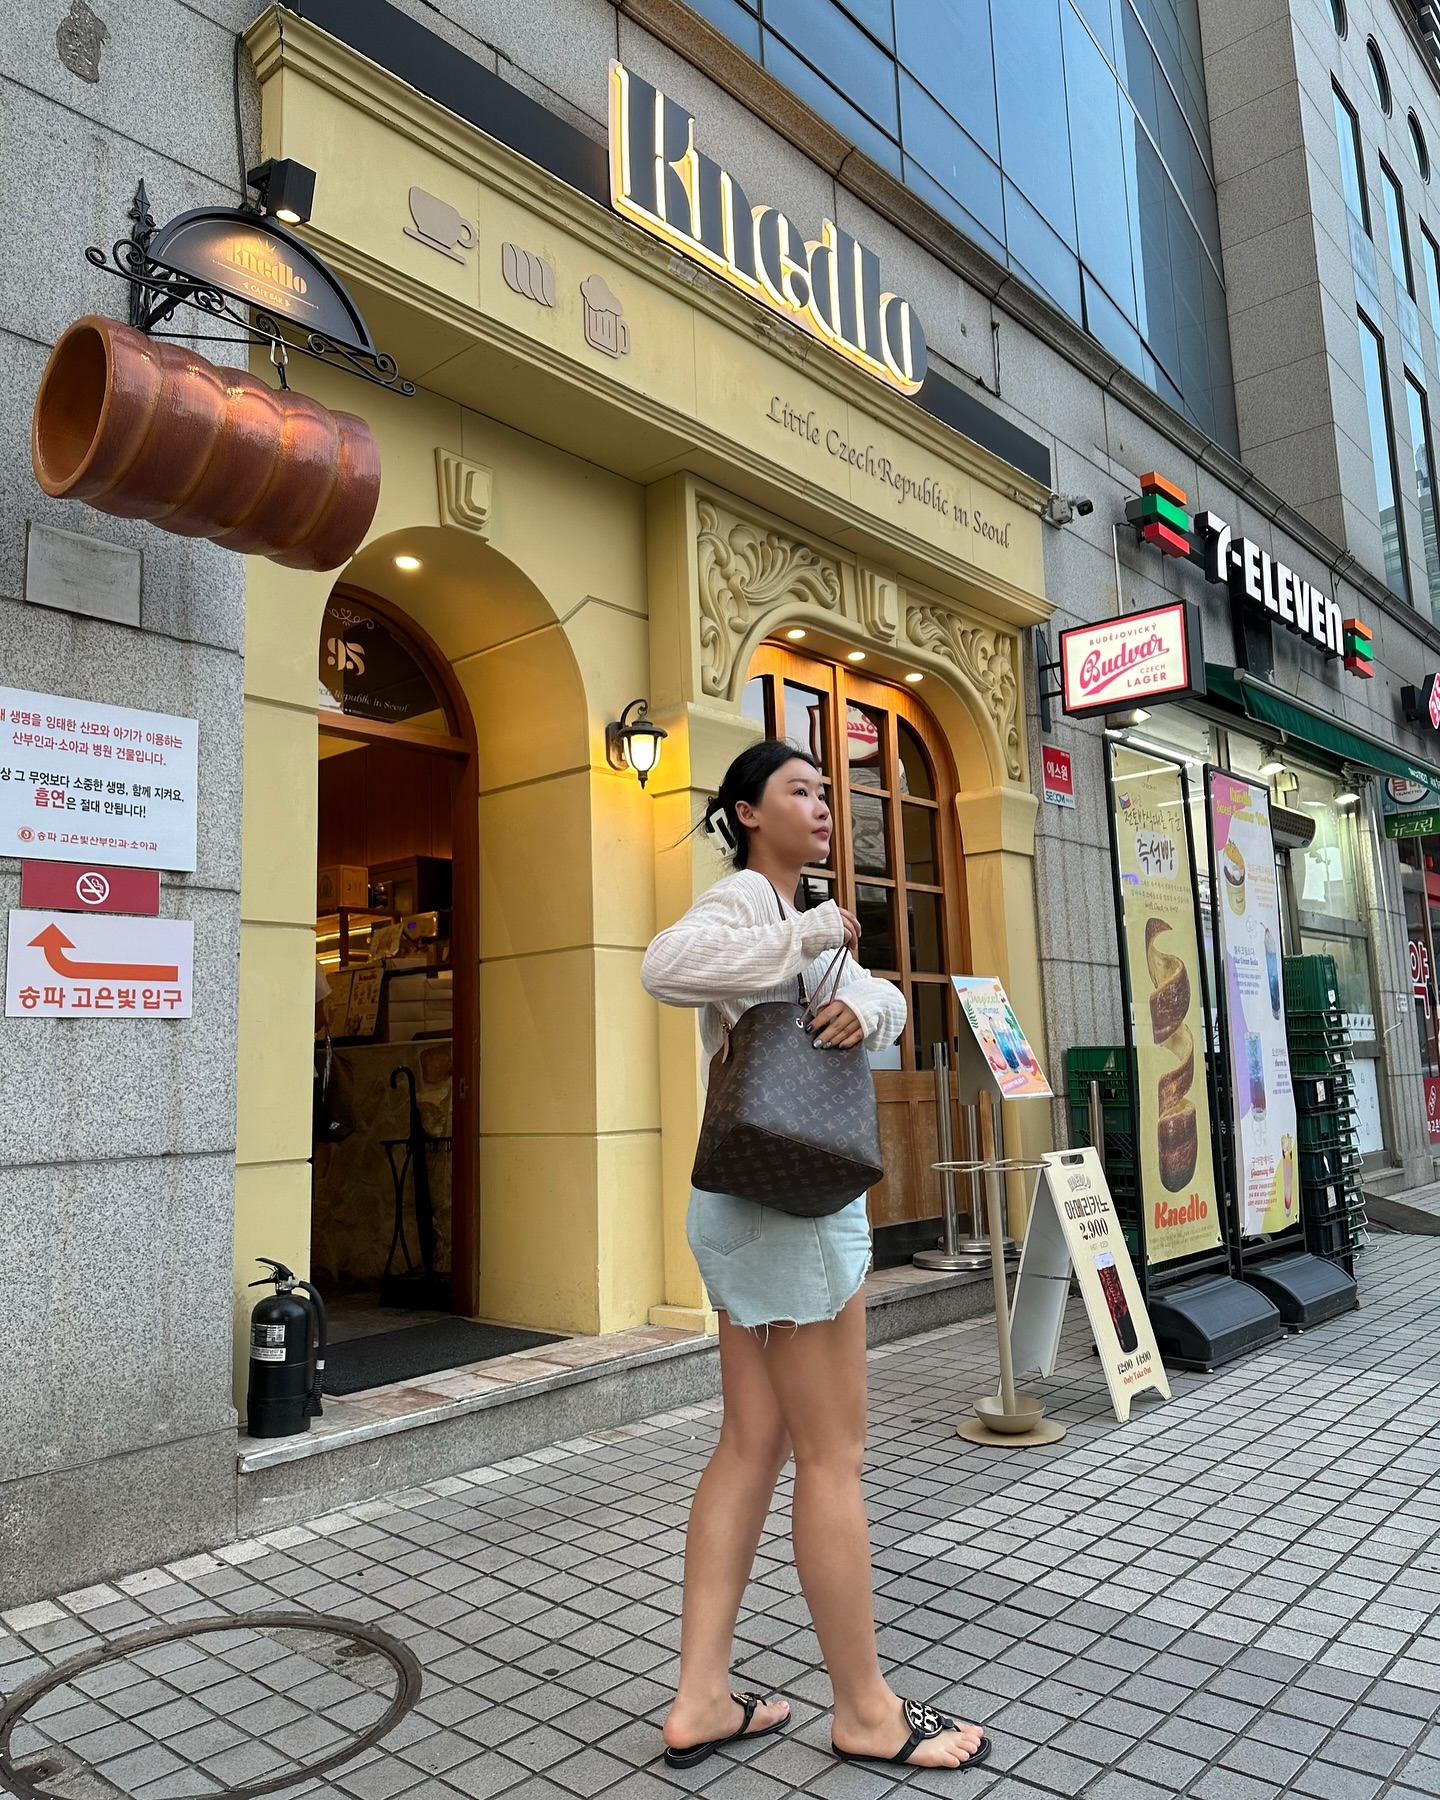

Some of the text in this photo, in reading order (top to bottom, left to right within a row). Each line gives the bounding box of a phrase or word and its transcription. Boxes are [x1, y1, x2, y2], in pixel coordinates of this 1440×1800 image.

[766, 396, 1012, 549] Little Czech Republic in Seoul
[1079, 633, 1169, 690] Budvar
[1140, 663, 1166, 675] CZECH
[1127, 672, 1168, 688] LAGER
[10, 709, 42, 727] 생명을
[46, 715, 76, 732] 잉태한
[80, 721, 110, 737] 산모와
[113, 727, 142, 743] 아기가
[146, 732, 183, 749] 이용하는
[93, 743, 112, 758] 병원
[116, 747, 167, 766] 건물입니다.
[1046, 761, 1069, 781] 에스원
[14, 769, 26, 782] 그
[29, 771, 70, 788] 무엇보다
[73, 774, 104, 792] 소중한
[132, 783, 151, 799] 함께
[154, 787, 185, 803] 지켜요.
[34, 787, 146, 819] 흡연은 절대 안됩니다!
[37, 830, 57, 842] 송파
[1392, 816, 1433, 837] 뉴그린
[1137, 833, 1175, 875] 즉석빵
[18, 986, 182, 1010] 송파 고은빛 입구
[1064, 1194, 1110, 1220] 아메리카노
[1154, 1192, 1208, 1230] Knedlo
[1123, 1366, 1152, 1385] Only Take Out
